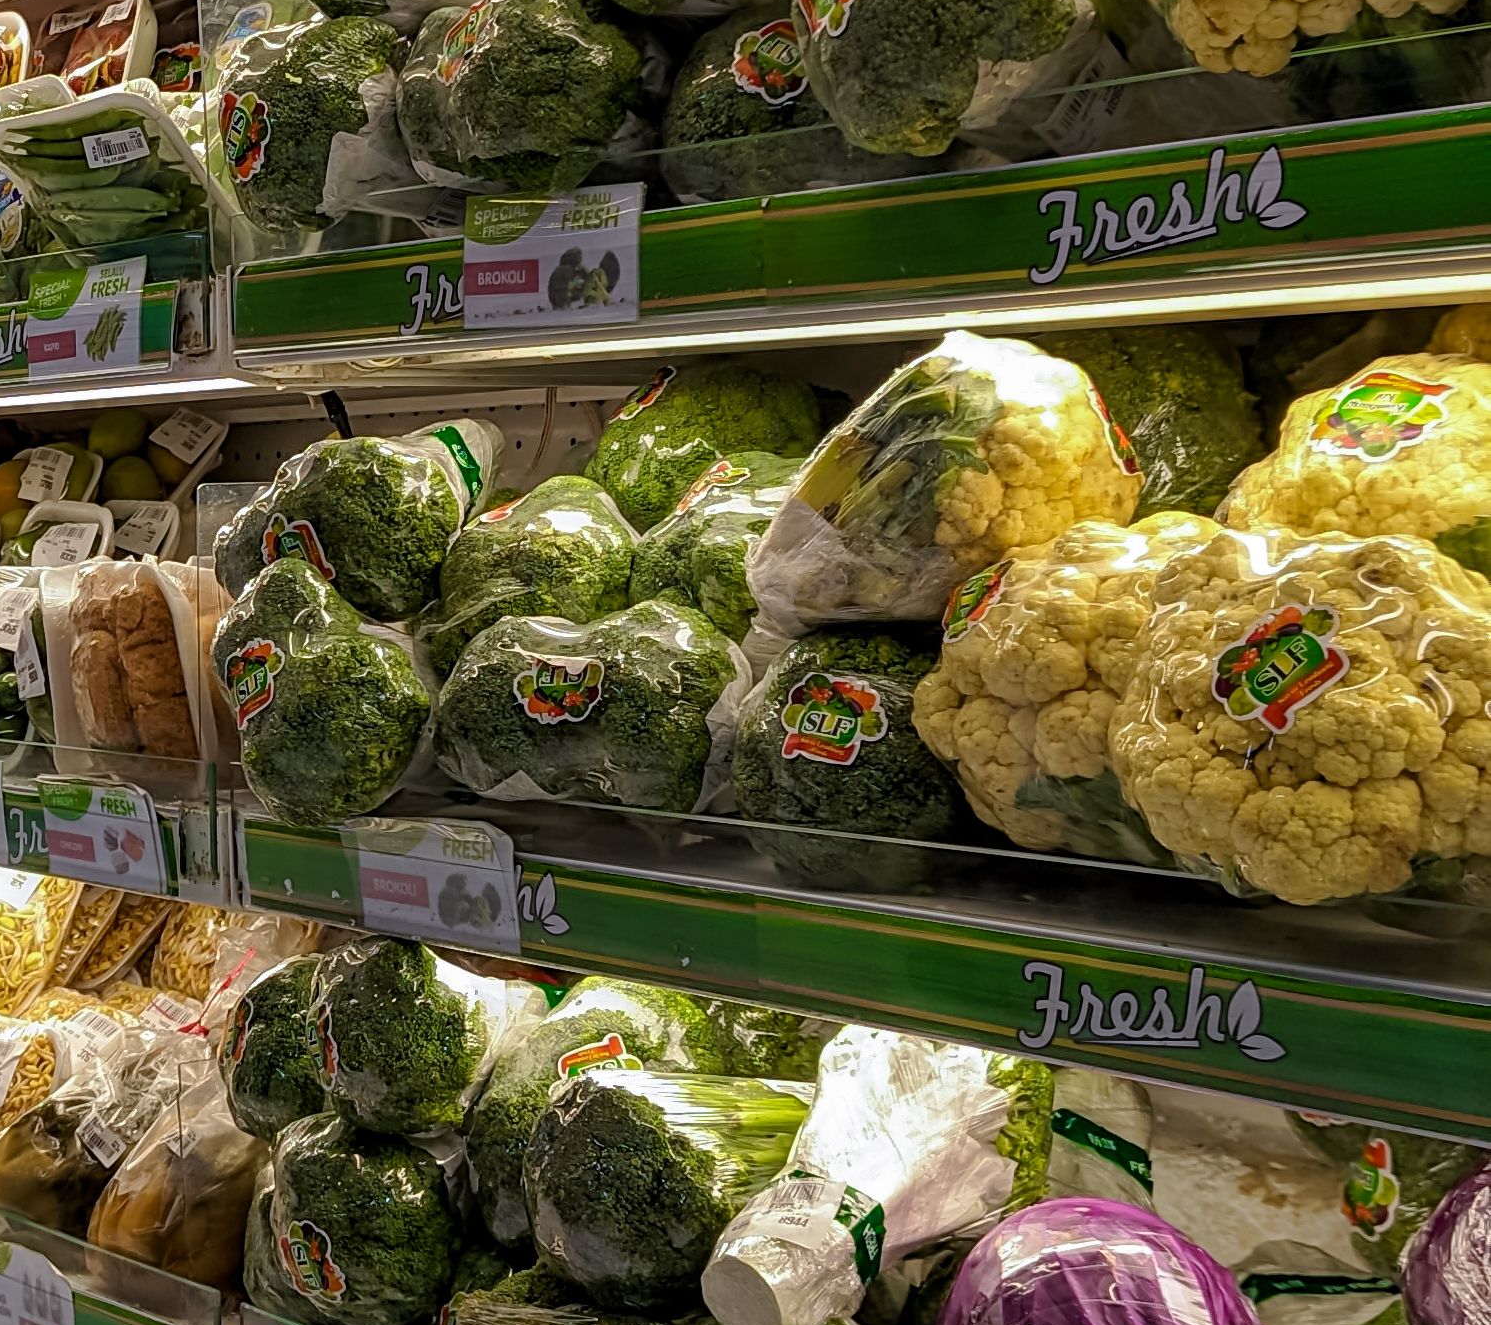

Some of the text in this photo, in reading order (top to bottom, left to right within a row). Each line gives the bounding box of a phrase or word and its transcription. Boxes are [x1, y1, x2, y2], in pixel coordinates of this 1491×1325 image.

[758, 38, 800, 65] SLF
[227, 110, 246, 161] SLF
[474, 204, 529, 226] SPECIAL
[560, 204, 620, 231] FRESH
[1029, 148, 1245, 285] Fresh
[34, 279, 72, 300] SPECIAL
[90, 276, 130, 300] FRESH
[477, 270, 526, 286] BROKOLI
[1254, 636, 1309, 696] SLF
[237, 667, 265, 704] SLF
[801, 711, 856, 739] SLF
[101, 796, 137, 818] FRESH
[442, 837, 496, 863] FRESH
[1017, 961, 1226, 1049] Fresh
